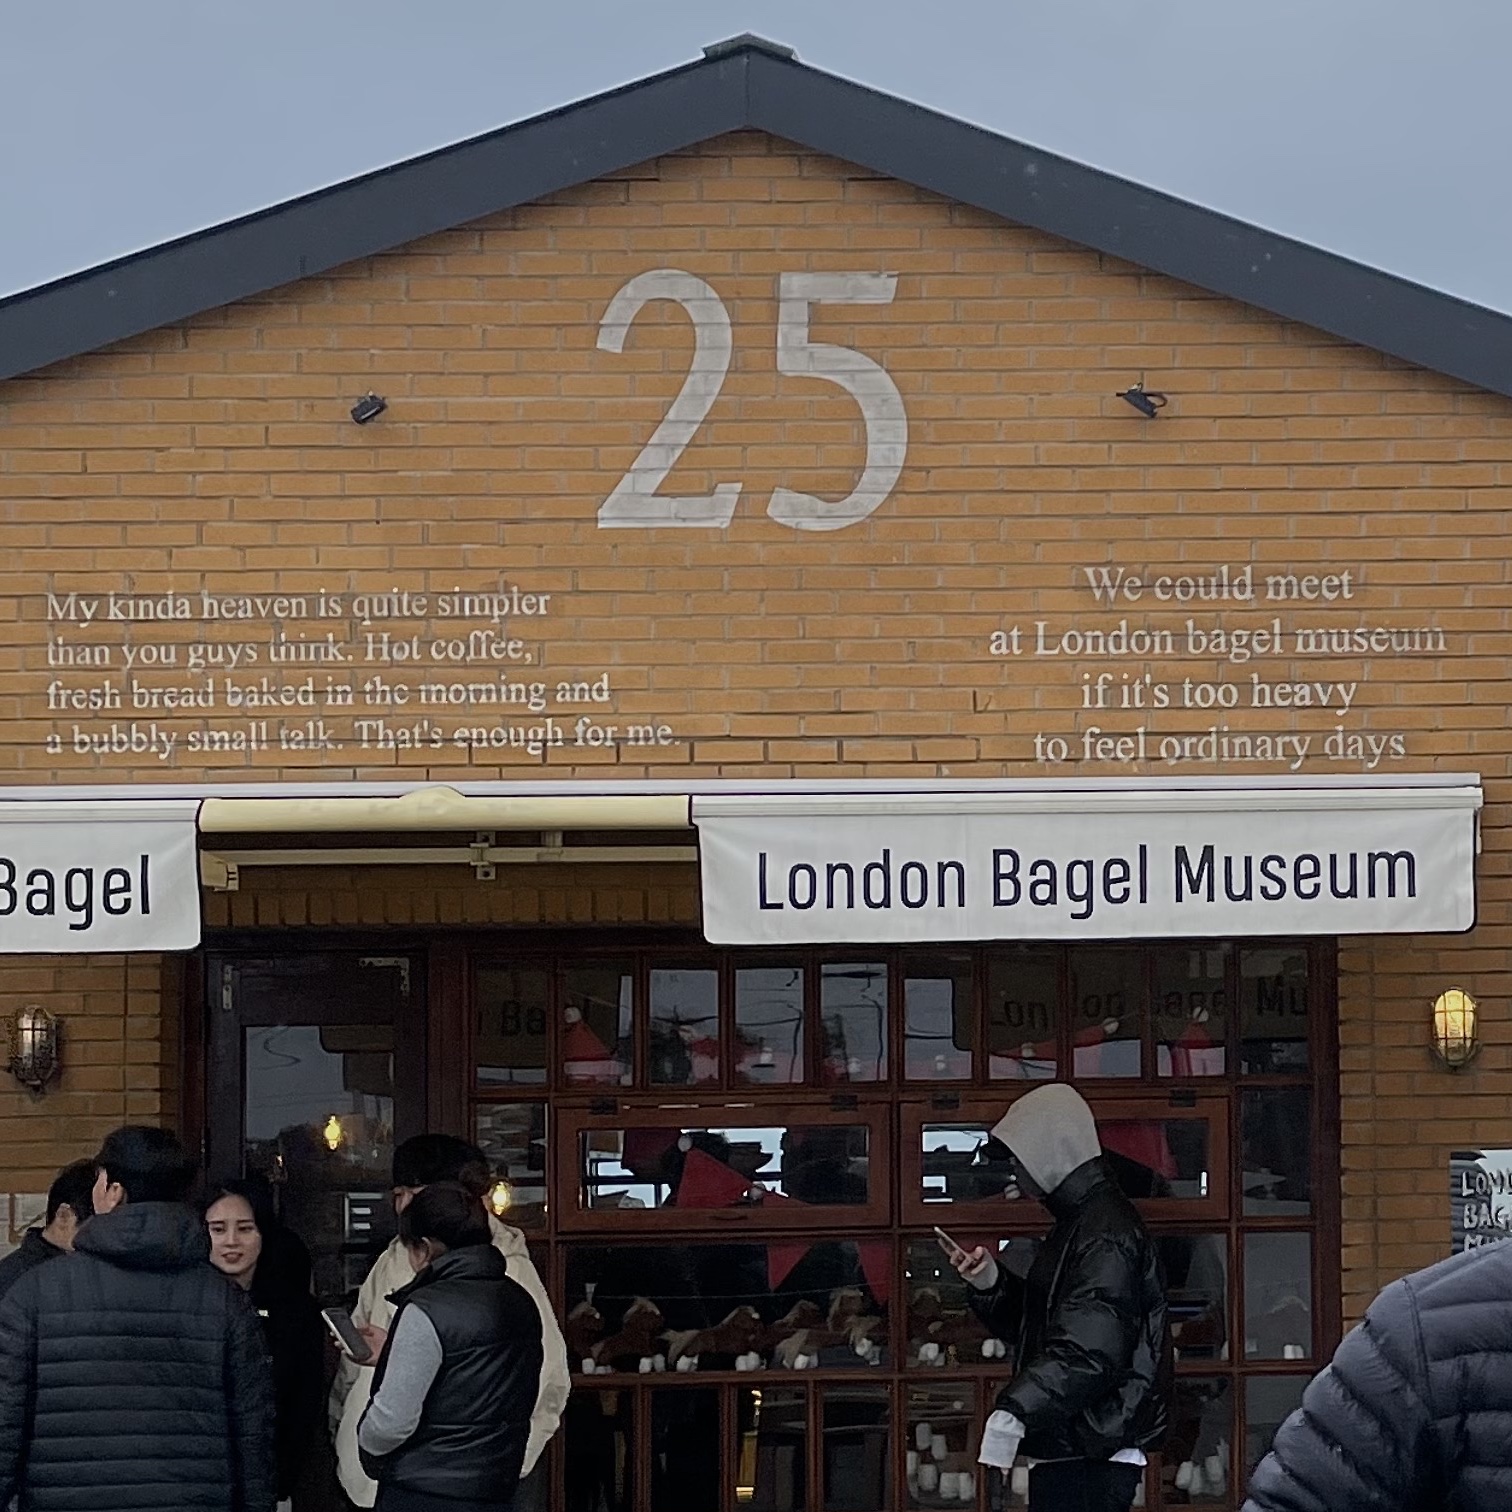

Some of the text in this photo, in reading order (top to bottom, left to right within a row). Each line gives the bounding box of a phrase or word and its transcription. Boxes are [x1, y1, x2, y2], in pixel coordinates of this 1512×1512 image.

[596, 268, 908, 531] 25
[1084, 565, 1354, 602] We could meet
[46, 585, 551, 627] My kinda heaven is quite simpler
[47, 629, 533, 673] than you guys think. Hot coffee,
[989, 617, 1448, 664] at London bagel museum
[47, 672, 611, 712] fresh bread baked in the morning and
[1082, 673, 1357, 716] if it's too heavy
[46, 717, 681, 761] a bubbly small talk. That's enough for me.
[1034, 725, 1406, 771] to feel ordinary days
[759, 844, 1417, 920] London Bagel Museum
